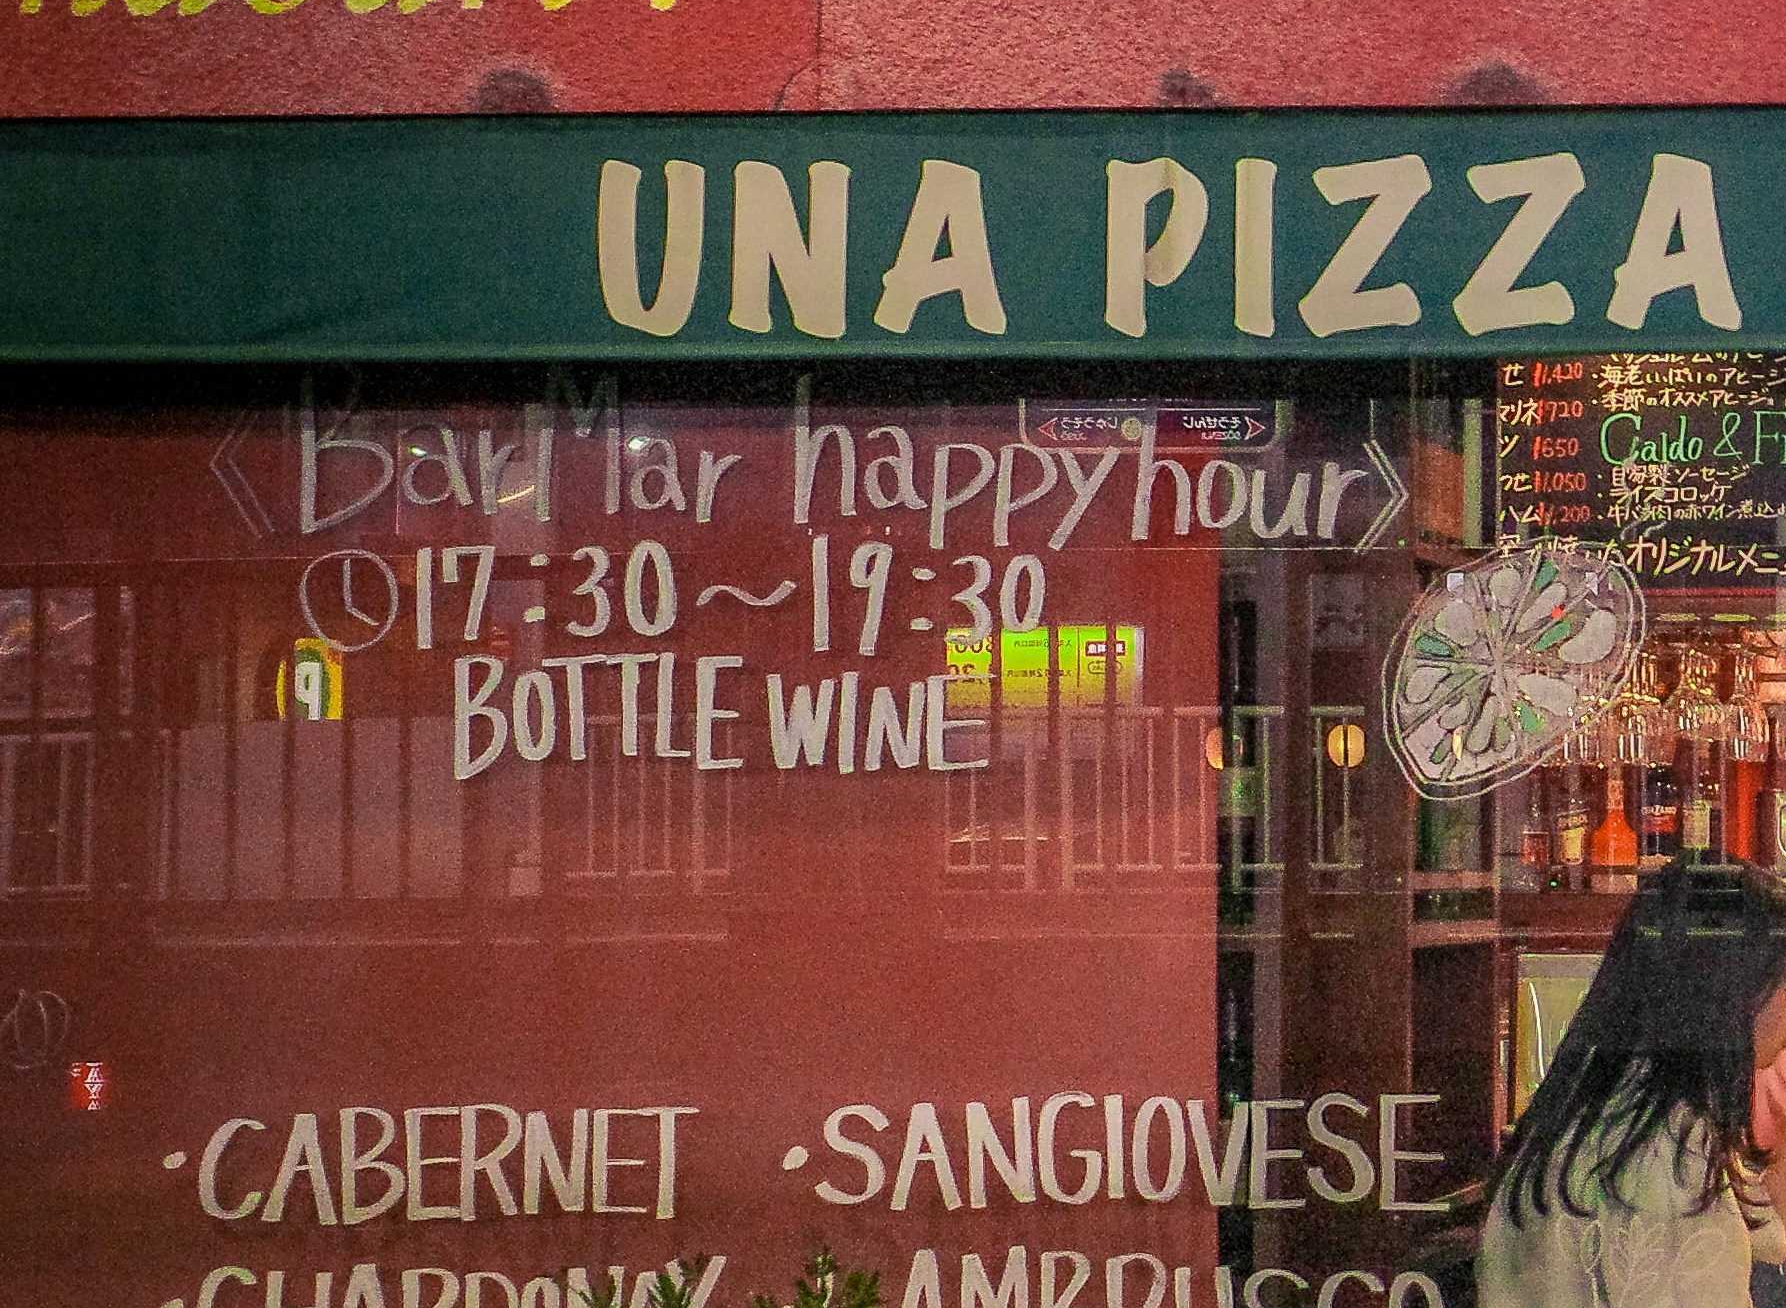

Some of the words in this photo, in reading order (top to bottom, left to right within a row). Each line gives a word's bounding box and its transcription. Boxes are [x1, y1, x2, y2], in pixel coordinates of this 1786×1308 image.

[597, 158, 1009, 340] UNA
[1103, 151, 1744, 340] PIZZA
[1713, 411, 1743, 461] &
[454, 654, 742, 779] BOTTLE
[765, 669, 992, 774] WINE
[198, 1101, 700, 1226] CABERNET
[813, 1092, 1452, 1214] SANGIOVESE
